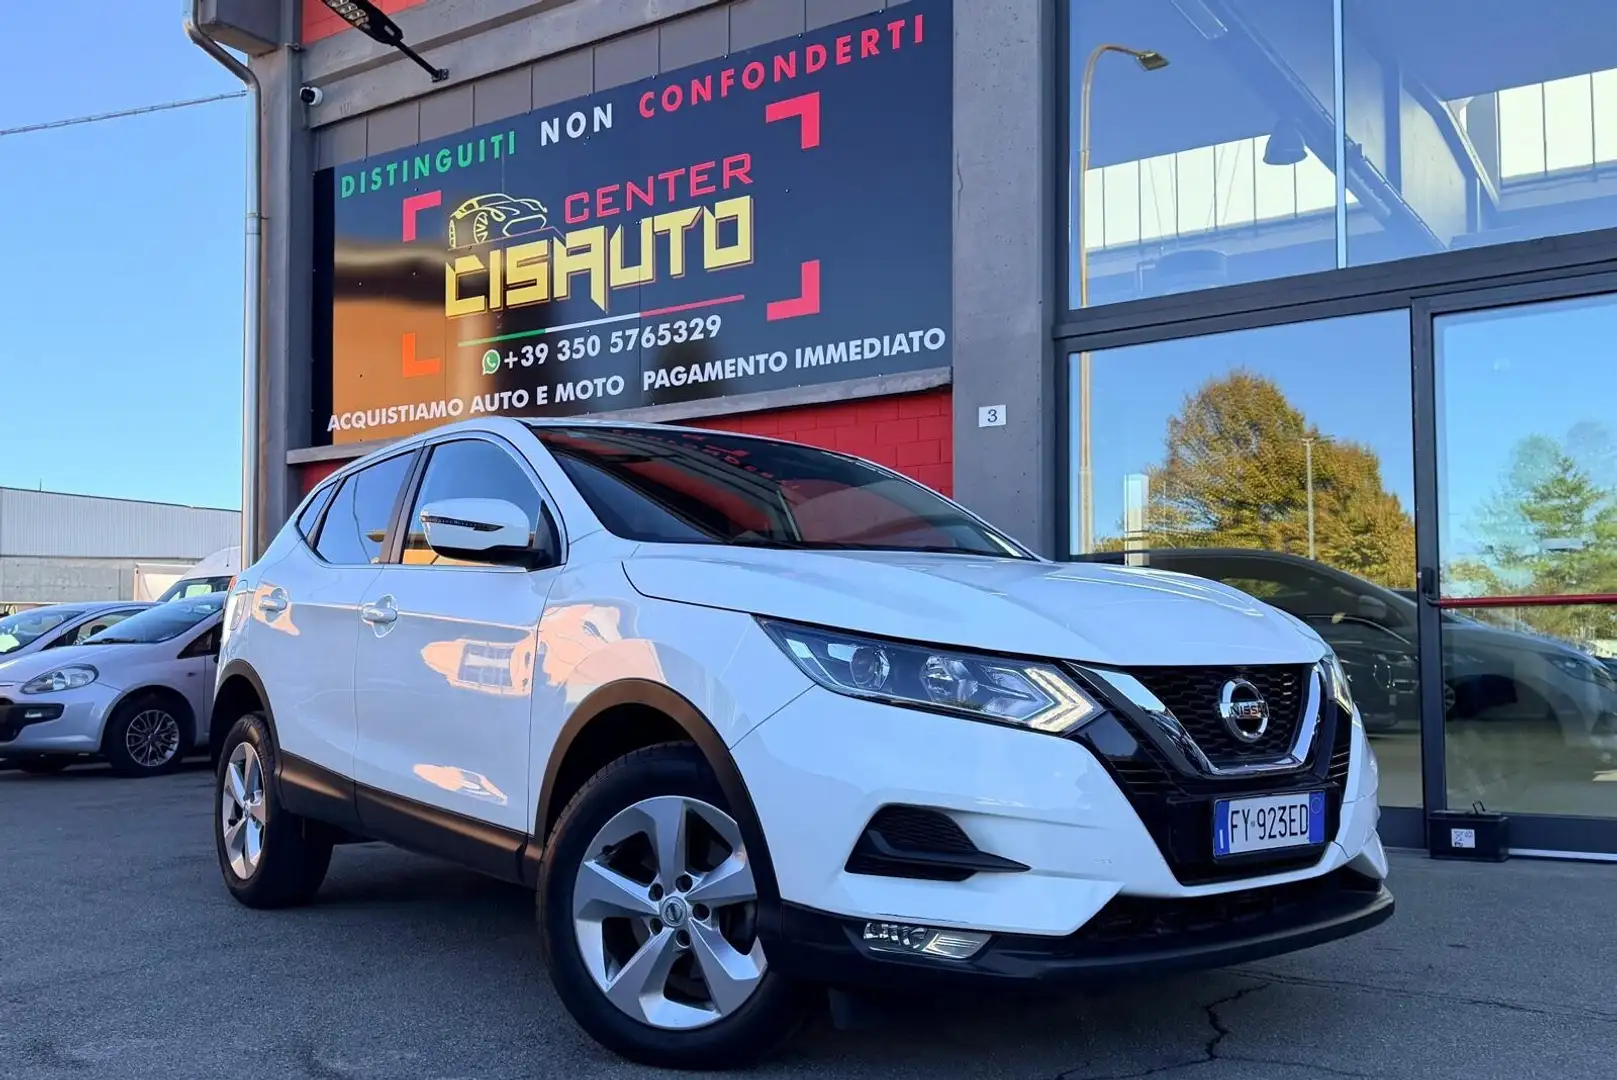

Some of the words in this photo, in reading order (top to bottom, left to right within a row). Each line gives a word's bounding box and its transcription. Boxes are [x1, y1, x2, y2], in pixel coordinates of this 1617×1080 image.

[341, 131, 515, 198] DISTINGUITI
[541, 103, 613, 146] NON
[639, 14, 923, 118] CONFONDERTI
[565, 153, 753, 224] CENTER
[445, 195, 754, 318] CISAUTO
[327, 399, 463, 431] ACQUISTIAMO
[470, 389, 529, 414] AUTO
[536, 386, 548, 405] E
[555, 375, 624, 402] MOTO
[643, 351, 788, 391] PAGAMENTO
[795, 328, 945, 369] IMMEDIATO
[504, 343, 548, 369] +39
[557, 335, 600, 361] 350
[610, 315, 722, 353] 5765329
[987, 408, 998, 423] 3
